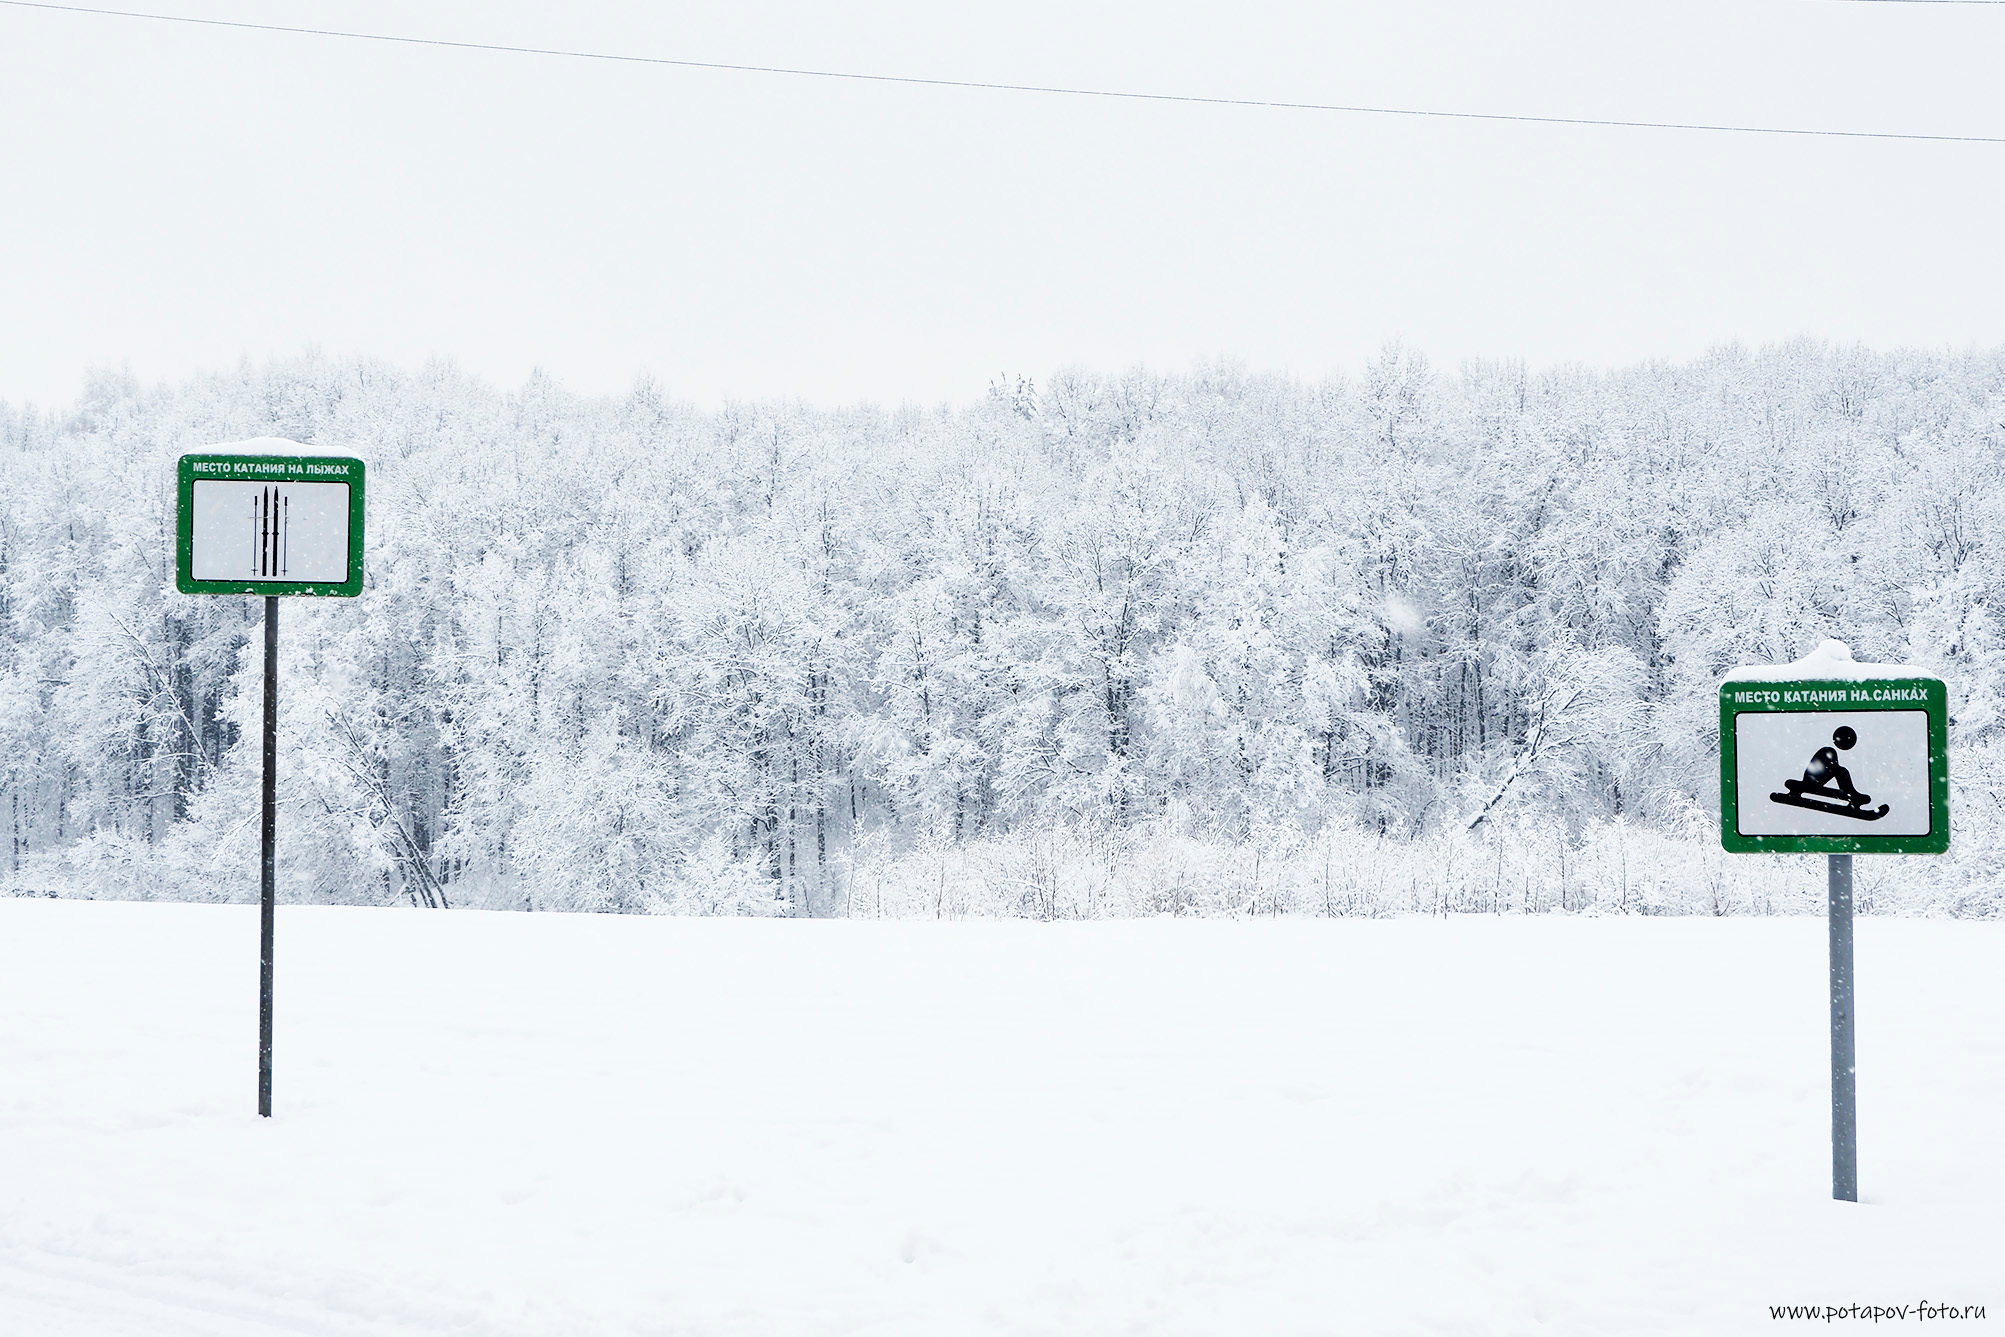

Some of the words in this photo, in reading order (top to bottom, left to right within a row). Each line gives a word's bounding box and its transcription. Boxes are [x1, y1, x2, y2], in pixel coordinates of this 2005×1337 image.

[193, 462, 231, 473] МЕСТО
[234, 463, 285, 474] КАТАНИЯ
[288, 464, 304, 474] НА
[305, 464, 349, 475] ЛЫЖАХ
[1734, 691, 1781, 703] МЕСТО
[1783, 690, 1847, 703] КАТАНИЯ
[1850, 690, 1868, 702] НА
[1873, 689, 1928, 701] САНКАХ
